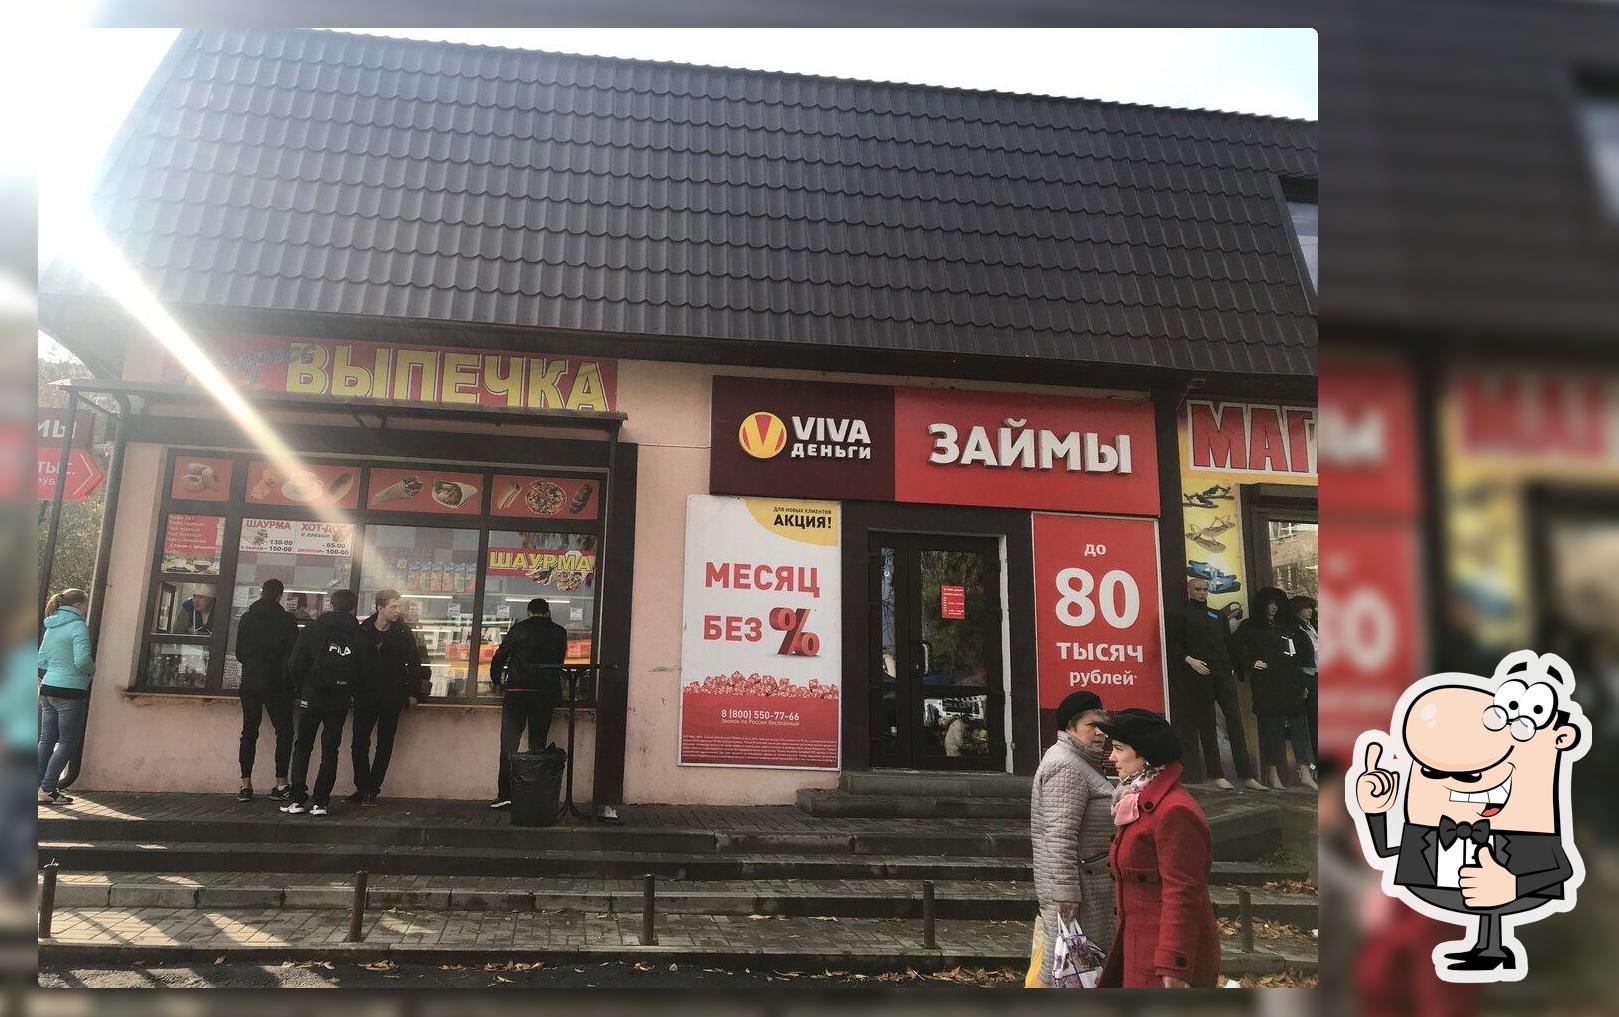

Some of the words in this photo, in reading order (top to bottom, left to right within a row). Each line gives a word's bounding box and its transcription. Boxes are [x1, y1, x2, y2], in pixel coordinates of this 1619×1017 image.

[285, 342, 609, 412] ВЫПЕЧКА
[791, 415, 872, 444] VIVA
[927, 417, 1132, 475] ЗАЙМЫ
[246, 519, 292, 530] ШАУРМА
[773, 513, 832, 530] АКЦИЯ!
[489, 550, 594, 572] ШАУРМА
[705, 561, 820, 599] МЕСЯЦ
[1054, 567, 1140, 630] 80
[703, 614, 763, 642] БЕЗ
[721, 709, 728, 718] 8
[753, 710, 800, 721] 550-77-66
